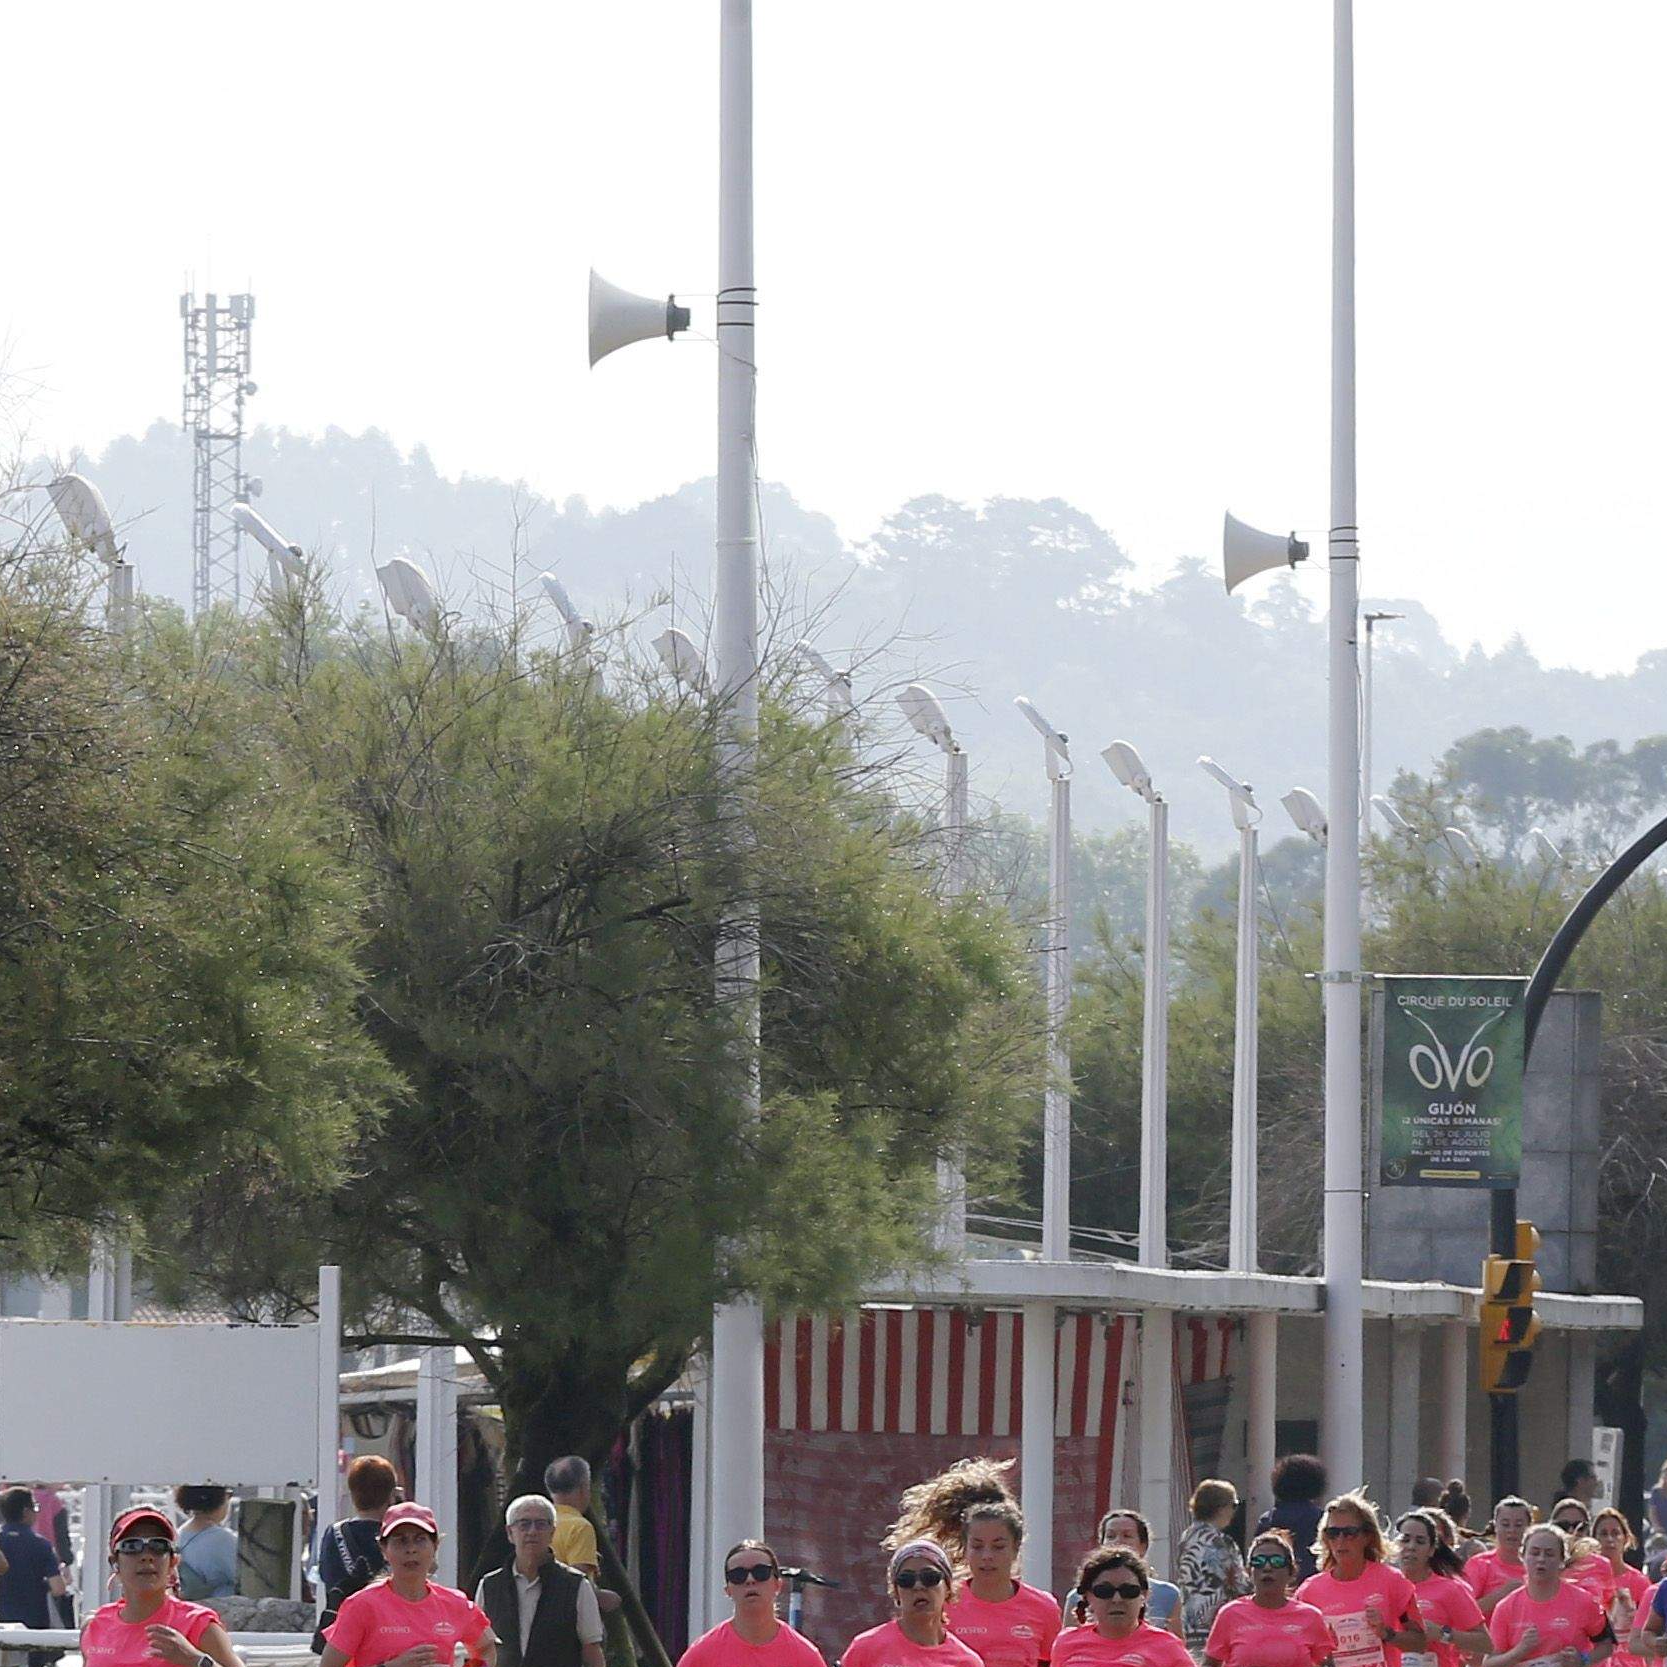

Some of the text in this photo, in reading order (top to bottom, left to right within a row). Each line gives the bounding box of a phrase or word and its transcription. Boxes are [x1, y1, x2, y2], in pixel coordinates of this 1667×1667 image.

[1397, 995, 1513, 1010] CIRQUE DU SOLEIL
[1407, 1025, 1499, 1092] OVO
[1428, 1101, 1477, 1115] GIJÓN
[1413, 1116, 1450, 1125] ÚNICAS
[1412, 1130, 1430, 1138] DEL
[1464, 1130, 1491, 1138] JULIO
[1451, 1139, 1491, 1147] AGOSTO
[1340, 1634, 1360, 1643] 016
